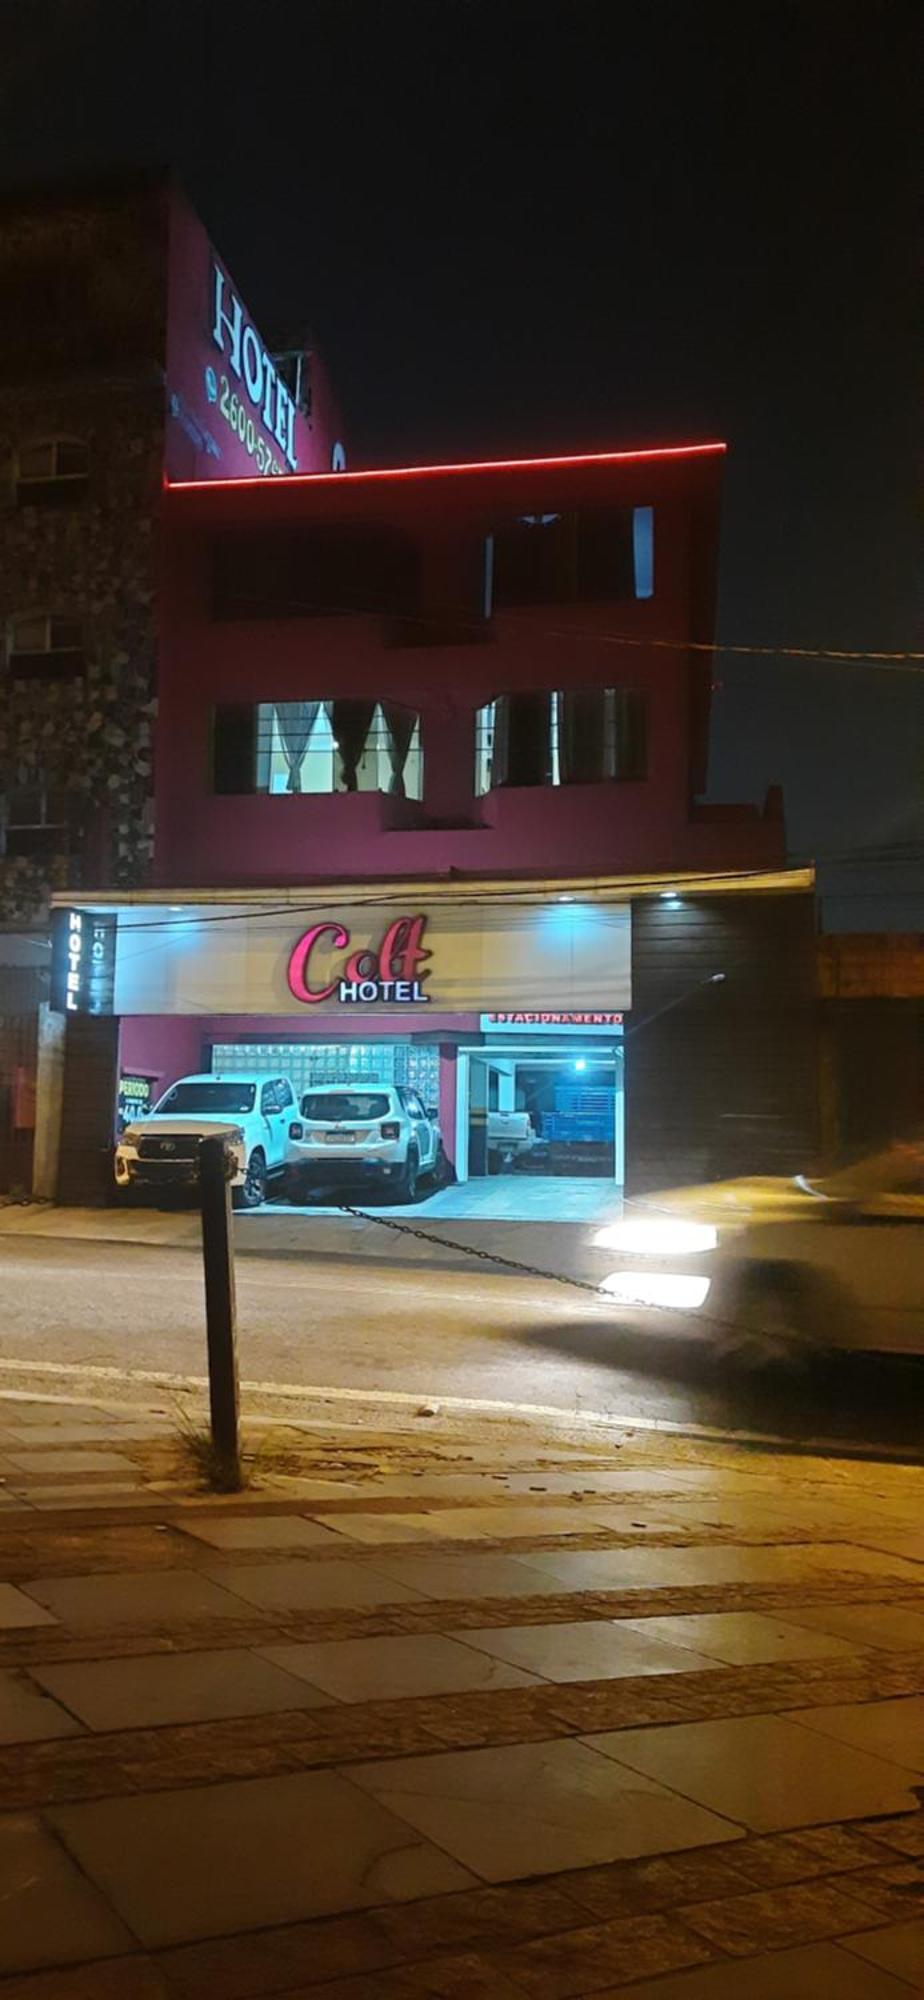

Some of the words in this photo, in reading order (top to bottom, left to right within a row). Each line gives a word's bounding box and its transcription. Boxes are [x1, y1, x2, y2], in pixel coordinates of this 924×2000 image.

[213, 263, 298, 472] HOTEL
[66, 912, 82, 1011] HOTEL
[288, 915, 433, 1003] Colt
[339, 980, 428, 1002] HOTEL
[488, 1013, 623, 1024] ESTACIONAMENTO
